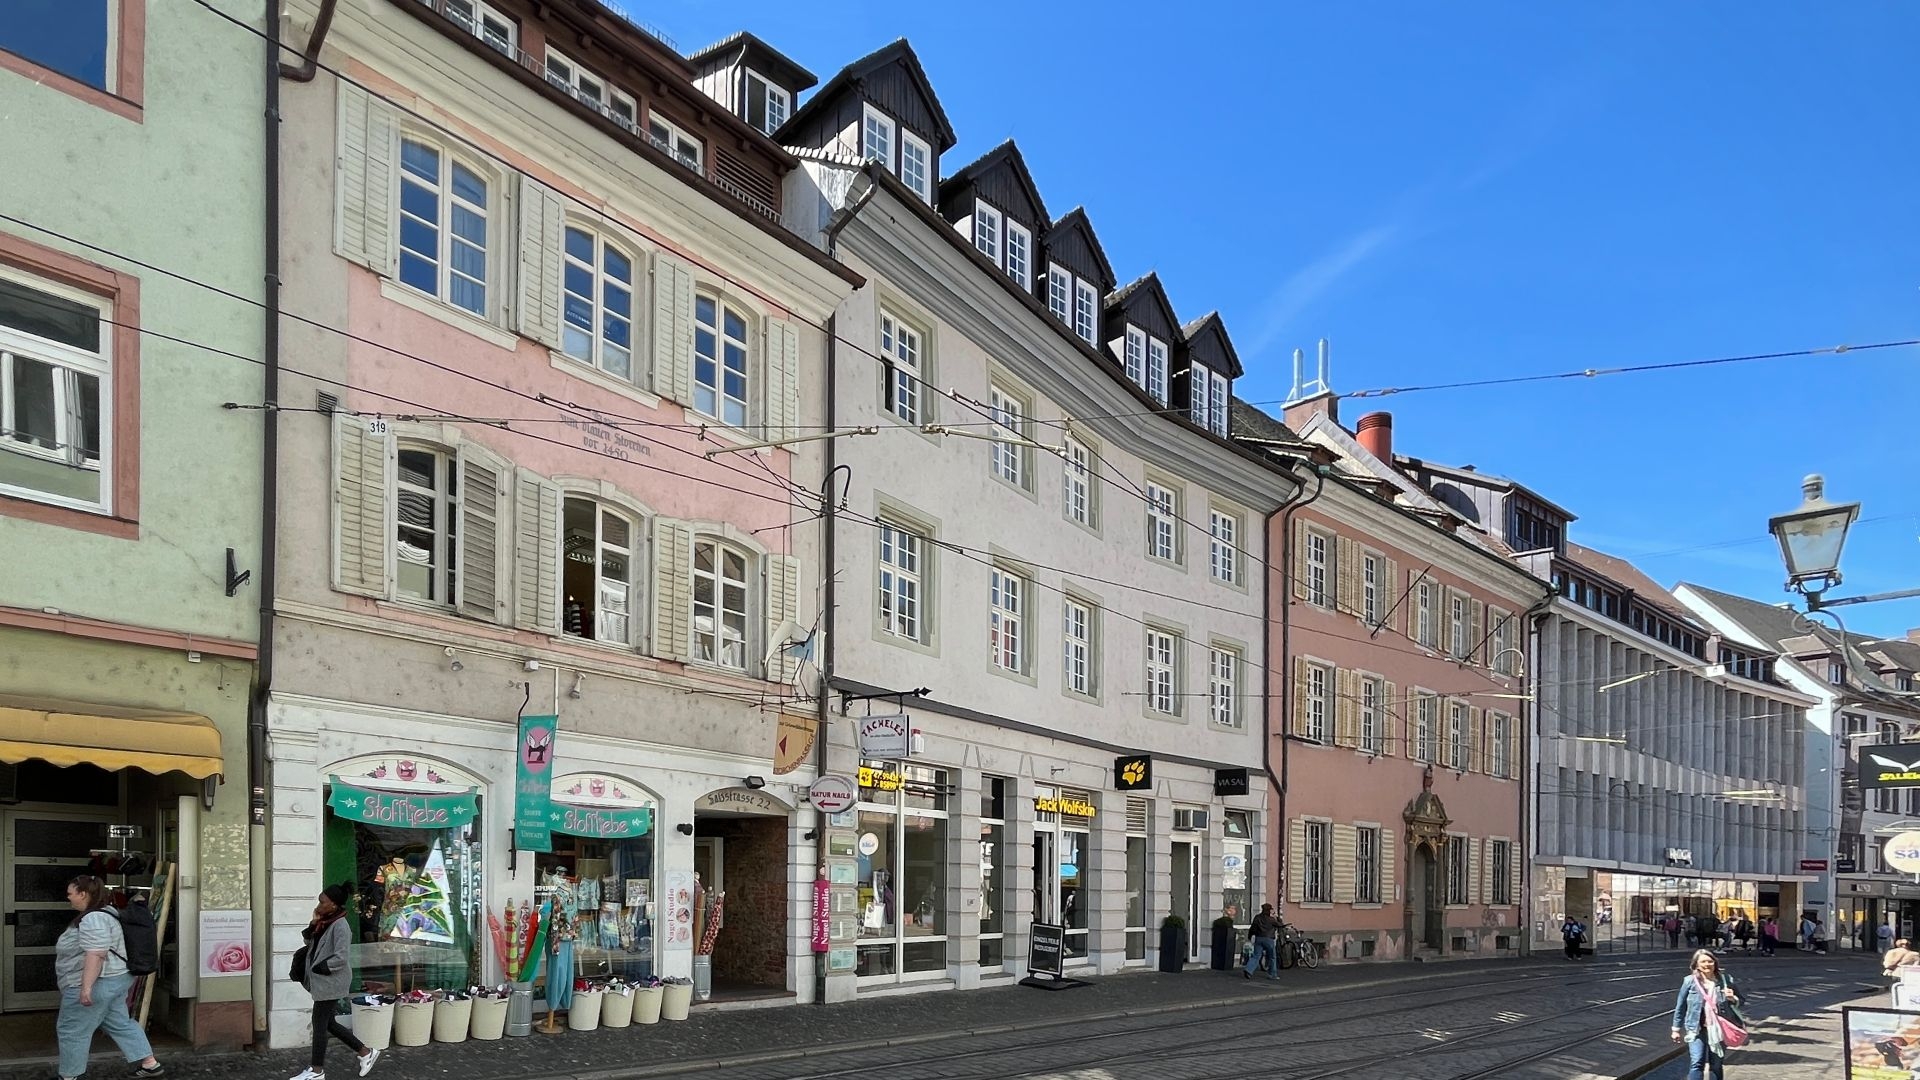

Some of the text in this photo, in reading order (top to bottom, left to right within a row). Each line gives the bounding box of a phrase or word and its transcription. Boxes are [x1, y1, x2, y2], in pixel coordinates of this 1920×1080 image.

[370, 421, 386, 433] 319
[583, 436, 599, 450] vor
[861, 719, 905, 737] TACHELES
[1231, 778, 1245, 786] SAL
[756, 797, 771, 810] 22
[832, 791, 851, 799] NAILS
[362, 794, 449, 828] Stoffliebe
[1035, 796, 1096, 817] Jack Wolfskin
[563, 808, 629, 836] Stoffliebe
[667, 888, 675, 943] Nagel Studio
[821, 888, 829, 945] Nagel Studio
[811, 918, 819, 943] Nagel
